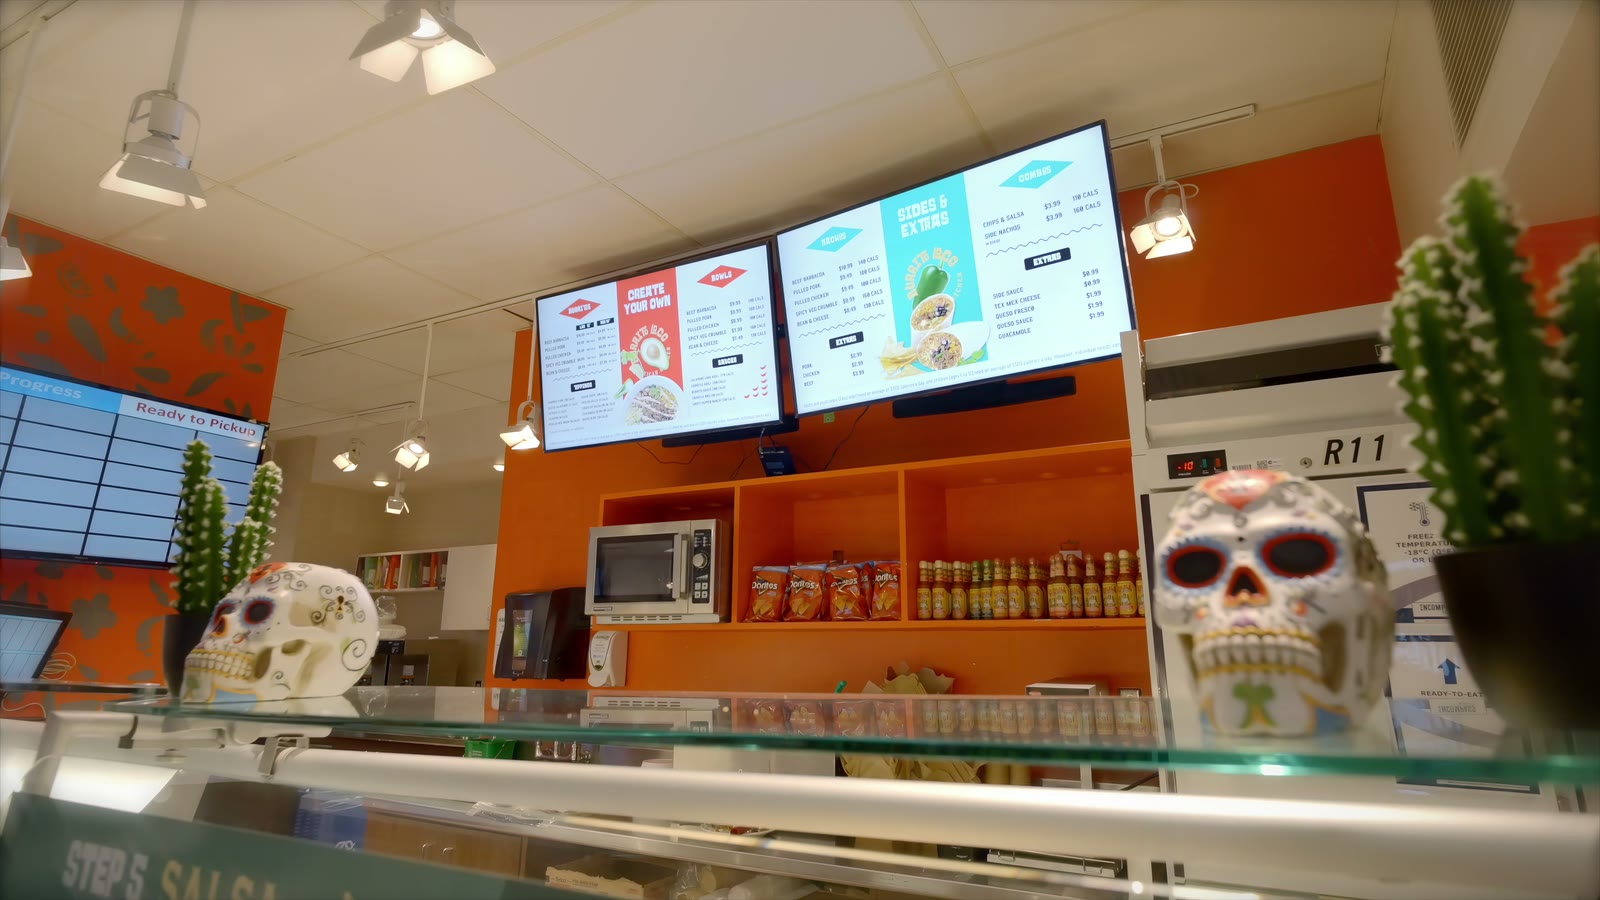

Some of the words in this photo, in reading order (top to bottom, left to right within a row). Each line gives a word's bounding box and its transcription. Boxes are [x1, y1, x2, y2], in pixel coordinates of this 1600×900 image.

[1018, 166, 1052, 182] COMBOS
[898, 198, 937, 222] SIDES
[983, 219, 999, 228] CHIPS
[1006, 211, 1024, 222] SALSA
[1044, 200, 1061, 210] $3.99
[1083, 189, 1099, 198] CALS
[985, 231, 998, 239] SIDE
[999, 224, 1021, 236] NACHOS
[1046, 212, 1063, 222] $3.99
[1085, 201, 1101, 211] CALS
[900, 211, 949, 238] EXTRAS
[1033, 252, 1061, 266] EXTRAS
[711, 271, 732, 282] BOWLS
[793, 286, 809, 295] PULLED
[868, 265, 880, 273] CALS
[803, 271, 825, 281] BARBACOA
[1006, 287, 1024, 296] SAUCE
[1082, 268, 1099, 278] $0.99
[628, 282, 665, 301] CREATE
[794, 297, 810, 306] PULLED
[811, 292, 829, 302] CHICKEN
[869, 277, 881, 285] CALS
[1020, 294, 1041, 304] CHEESE
[1084, 278, 1101, 288] $0.99
[624, 300, 648, 315] YOUR
[650, 294, 671, 310] OWN
[818, 301, 838, 311] CRUMBLE
[995, 311, 1013, 320] QUESO
[1014, 306, 1035, 316] FRESCO
[1086, 290, 1102, 299] $1.99
[997, 321, 1014, 330] QUESO
[1015, 316, 1033, 326] SAUCE
[1088, 301, 1103, 310] $1.99
[813, 314, 829, 322] CHEESE
[998, 328, 1031, 339] GUACAMOLE
[1089, 311, 1105, 320] $1.99
[0, 371, 81, 399] Progress
[136, 402, 186, 422] Ready
[190, 413, 205, 425] to
[210, 418, 256, 437] Pickup
[1323, 434, 1385, 466] R11
[1177, 460, 1194, 471] -10
[790, 580, 816, 589] Doritos
[1420, 690, 1483, 698] READY-TO-EAT
[61, 840, 126, 898] STEP
[125, 854, 148, 900] 5
